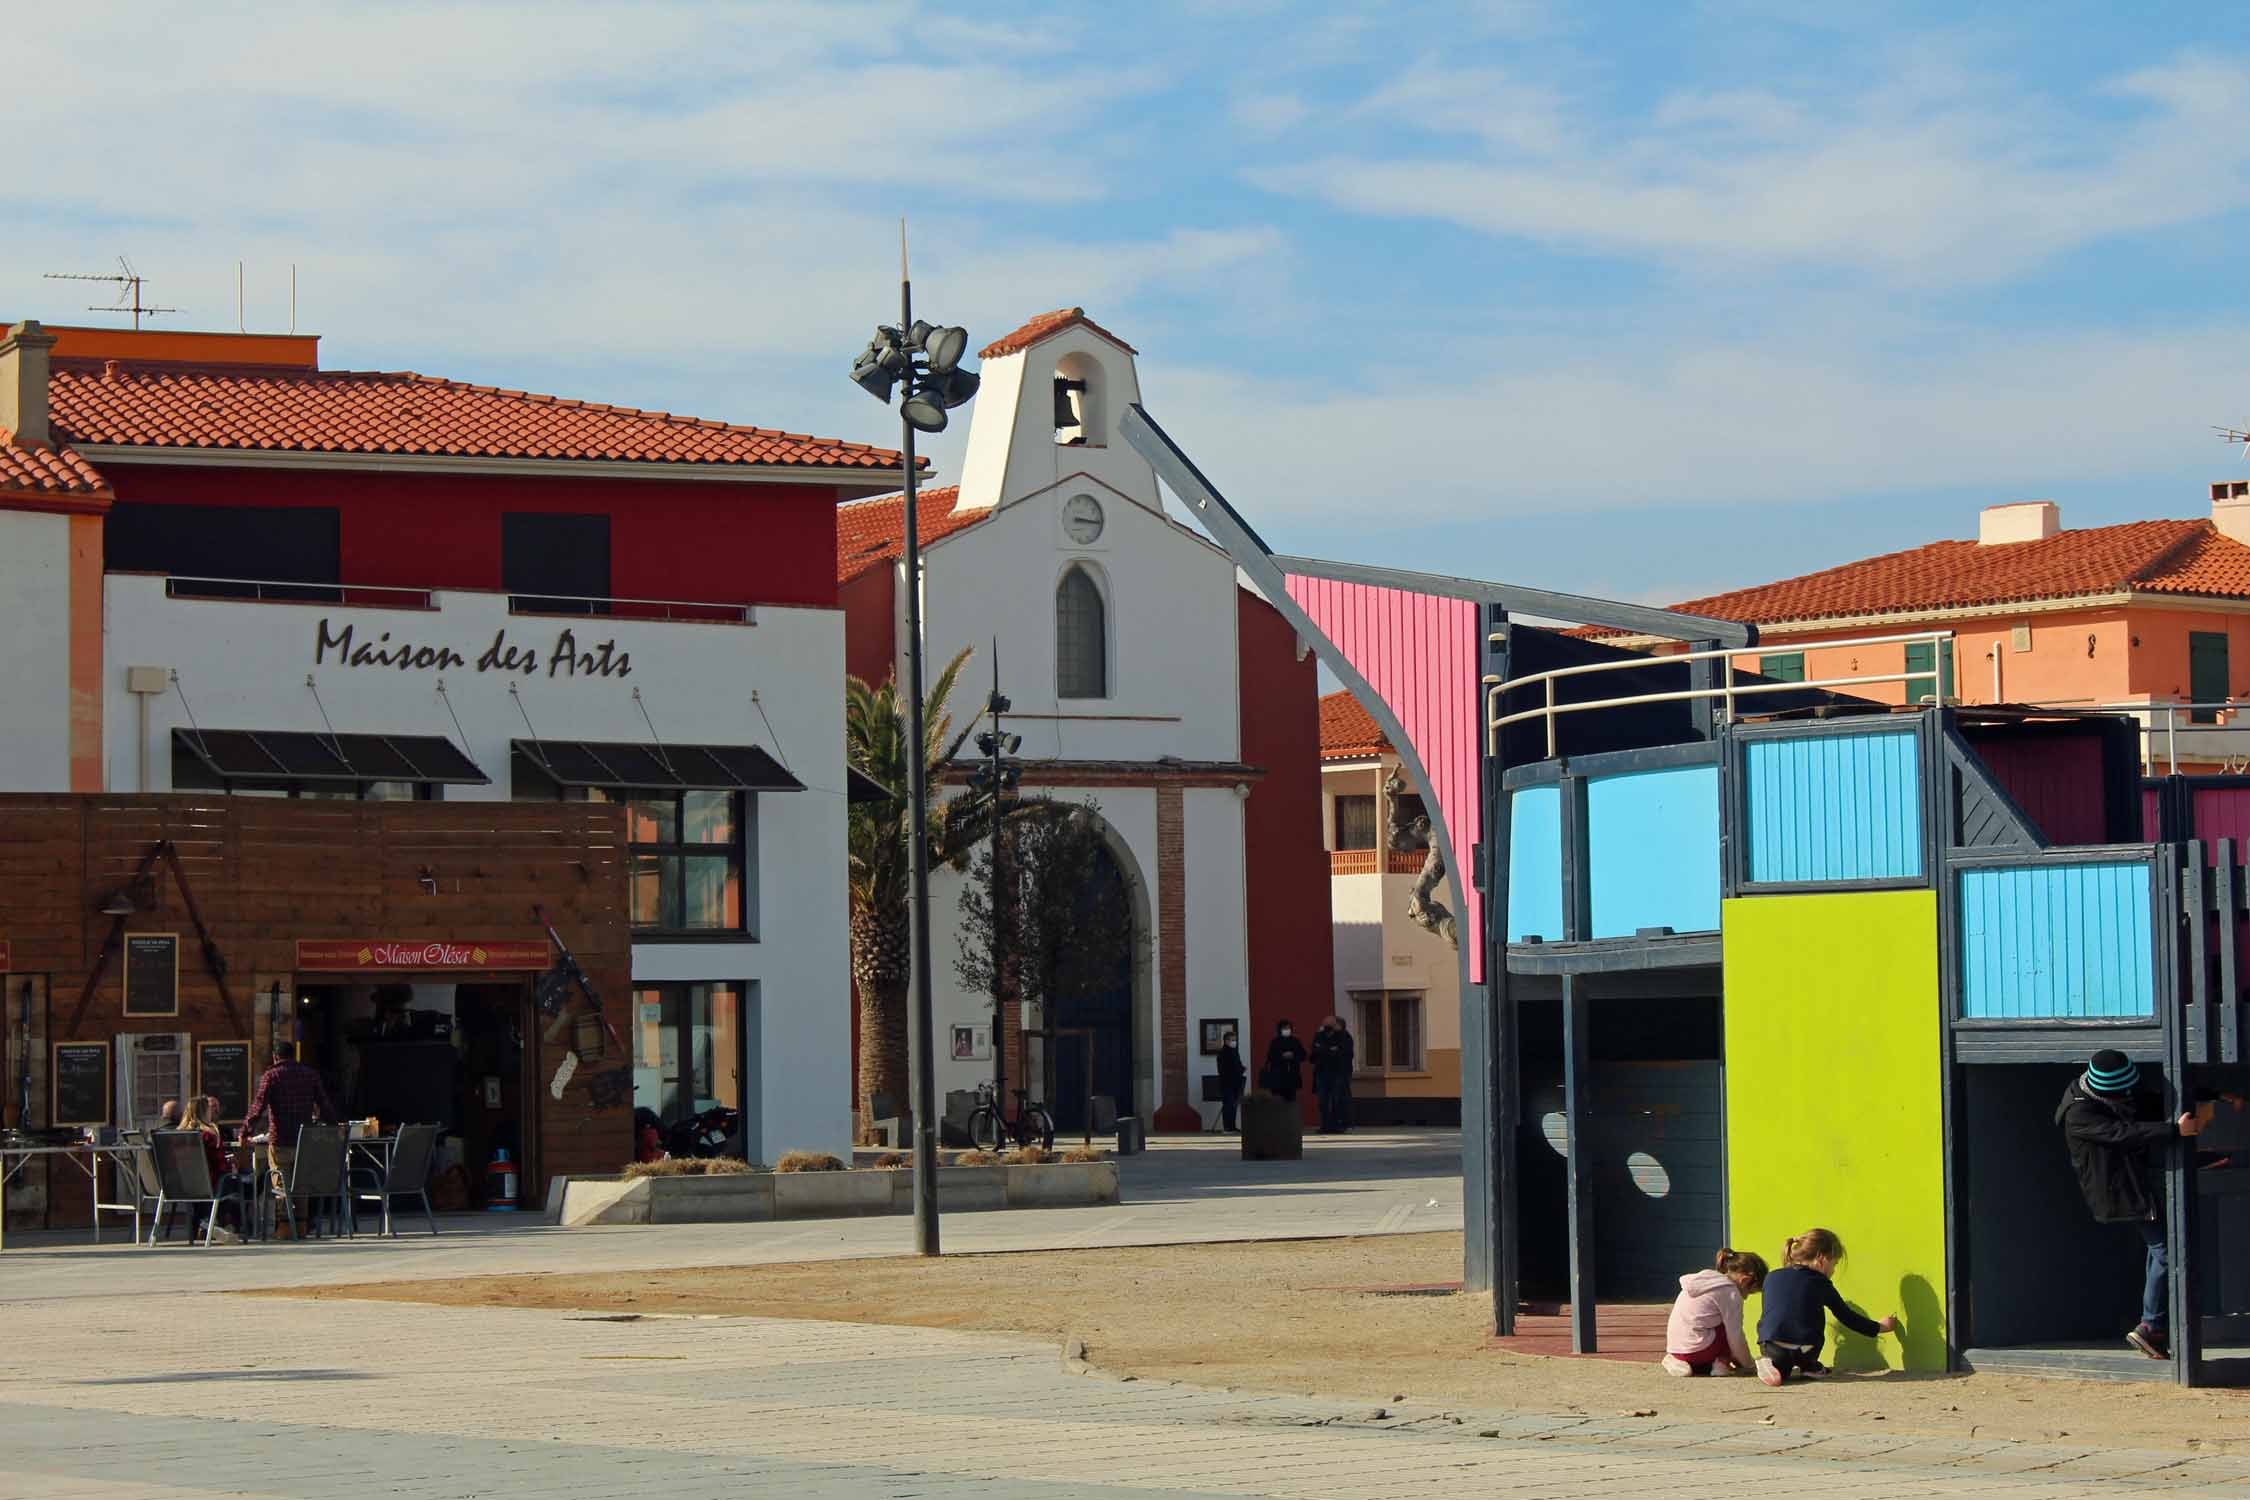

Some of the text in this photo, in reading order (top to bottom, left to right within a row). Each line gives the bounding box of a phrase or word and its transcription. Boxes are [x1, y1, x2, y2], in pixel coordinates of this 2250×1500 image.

[315, 618, 632, 678] Maison des Arts
[374, 943, 421, 964] Maison
